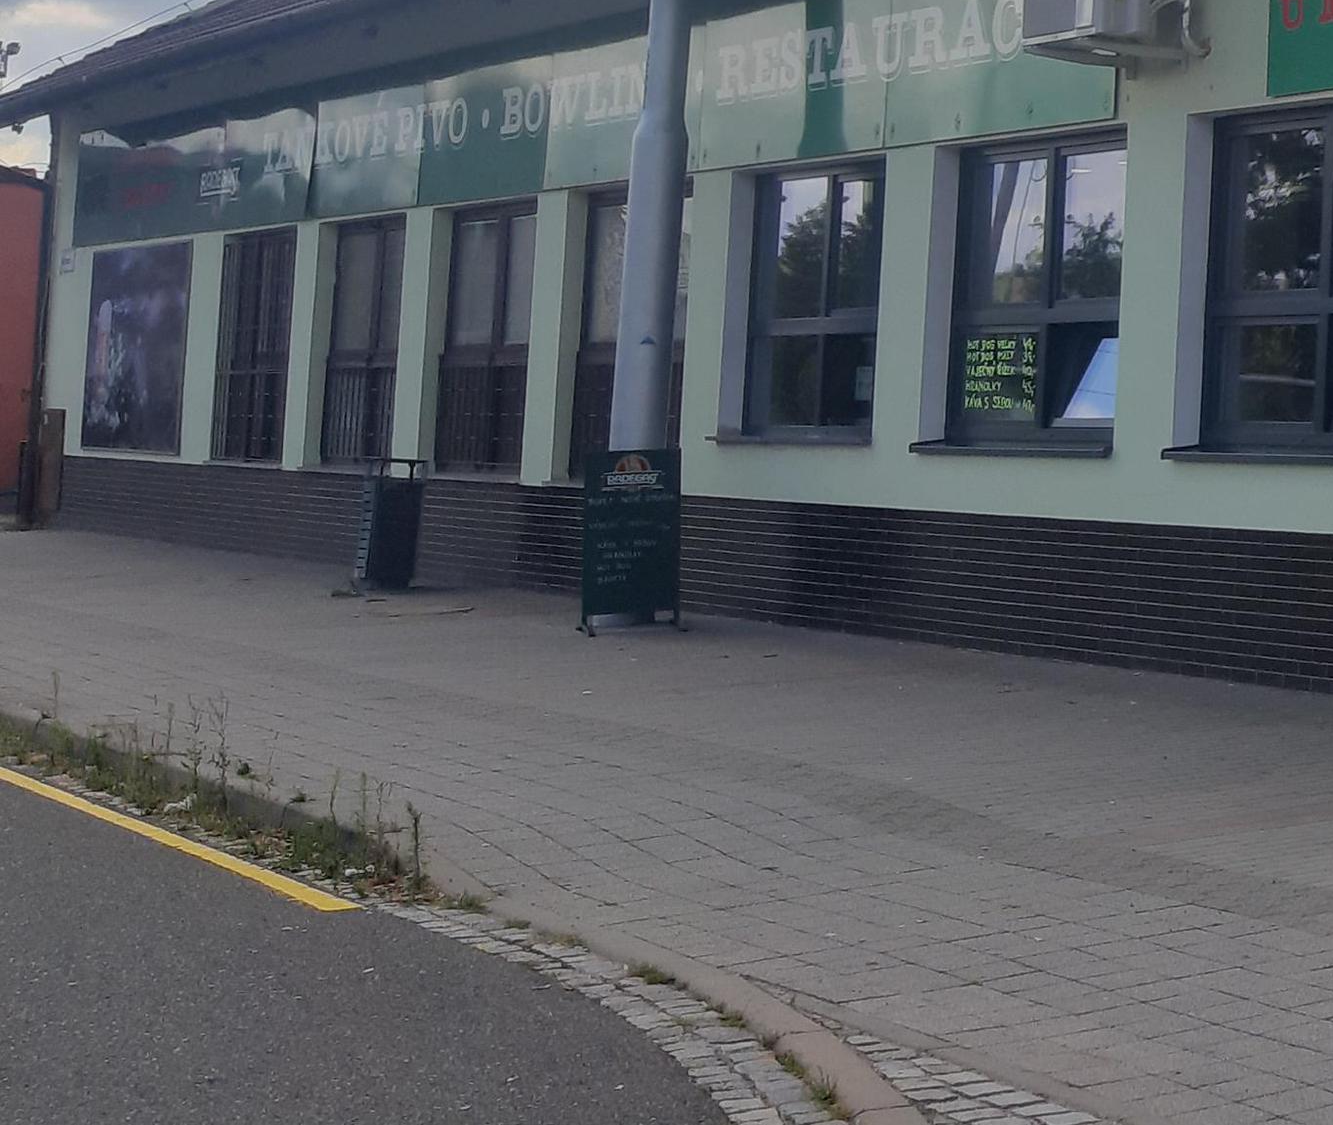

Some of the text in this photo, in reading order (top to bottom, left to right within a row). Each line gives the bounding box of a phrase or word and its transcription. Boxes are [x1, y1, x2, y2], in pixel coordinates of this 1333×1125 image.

[263, 90, 389, 176] TANKOVÉ
[395, 97, 469, 158] PIVO
[501, 61, 647, 141] BOWLIN
